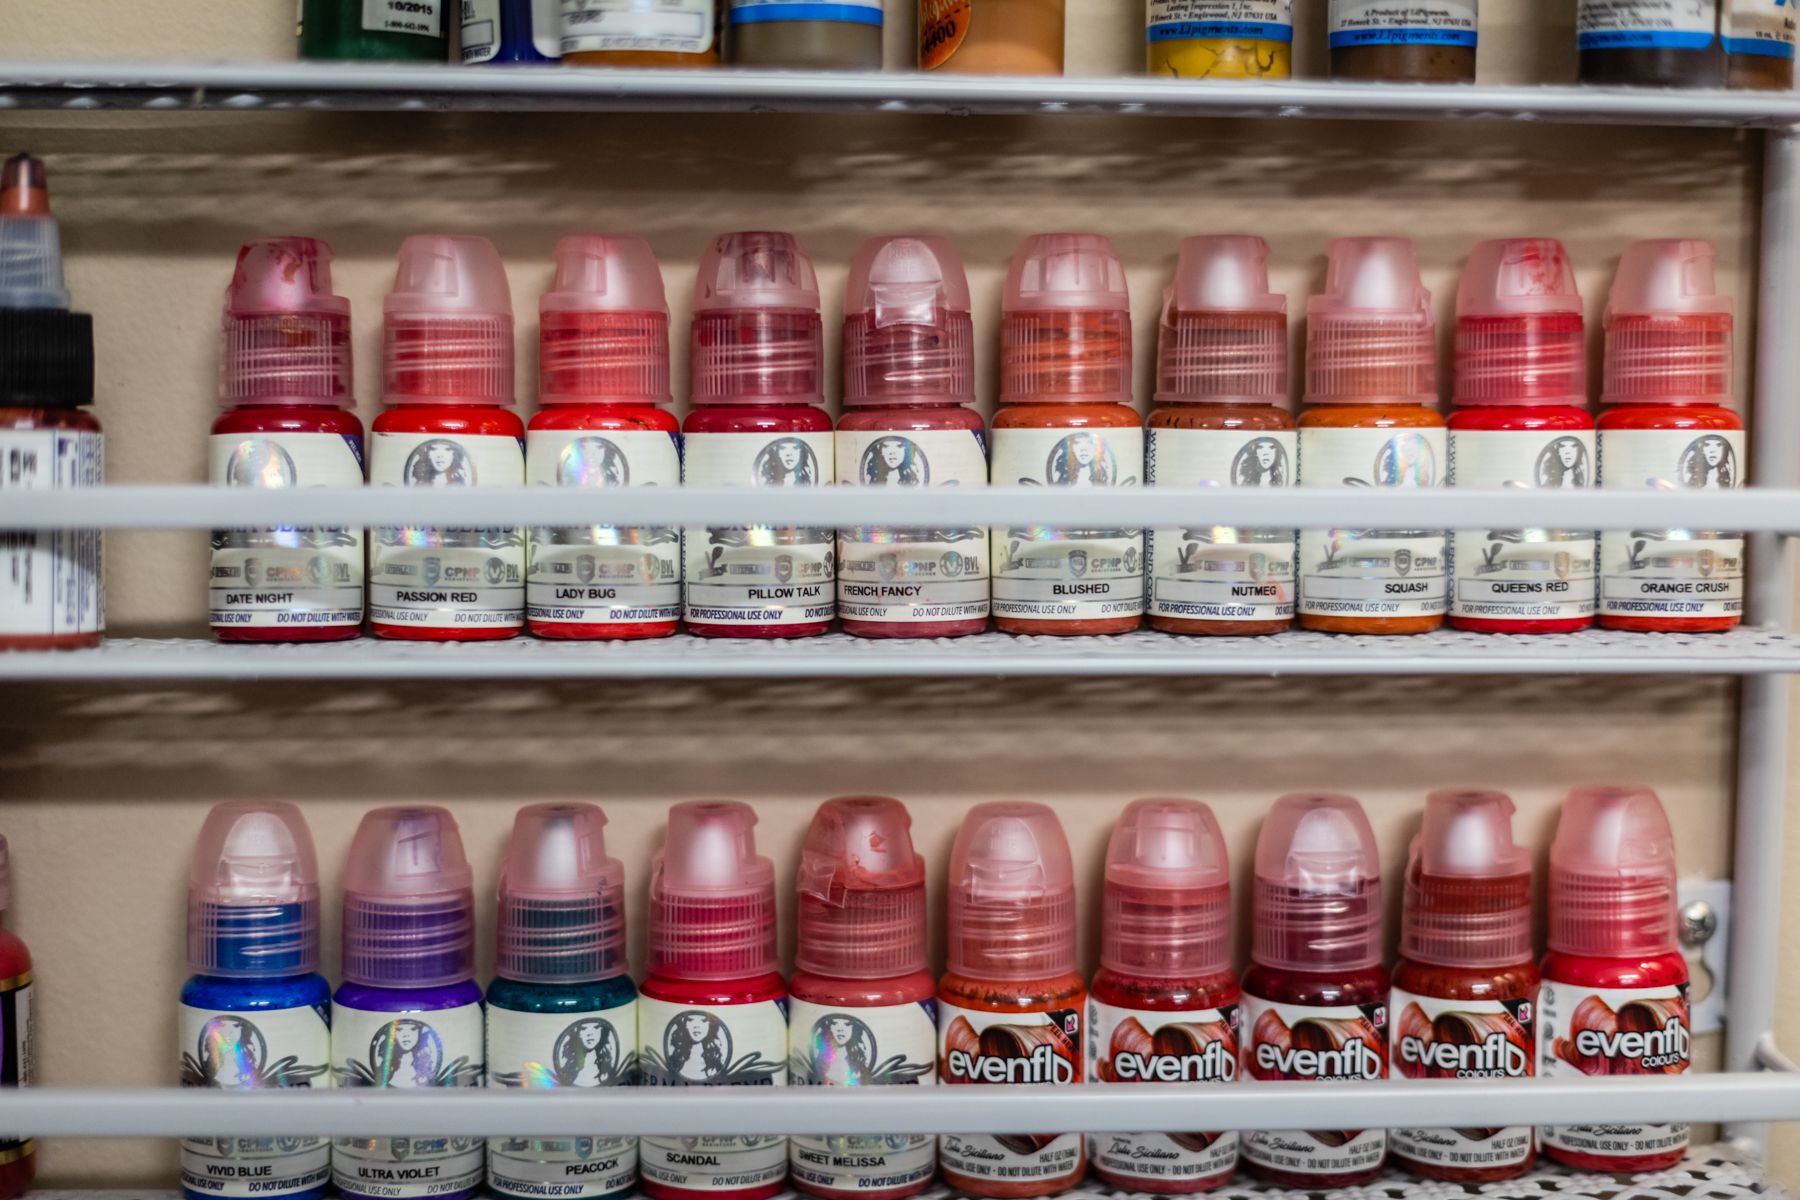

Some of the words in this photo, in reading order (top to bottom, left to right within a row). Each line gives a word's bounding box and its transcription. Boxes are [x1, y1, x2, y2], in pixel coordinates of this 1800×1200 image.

[964, 555, 980, 570] BVL
[555, 588, 586, 599] LADY
[588, 588, 616, 599] BUG
[748, 587, 794, 599] PILLOW
[796, 585, 821, 597] TALK
[844, 585, 878, 597] FRENCH
[881, 586, 922, 597] FANCY
[1053, 583, 1110, 595] BLUSHED
[1231, 585, 1277, 596] NUTMEG
[1384, 582, 1428, 594] SQUASH
[1491, 583, 1543, 594] QUEENS
[1545, 581, 1569, 592] RED
[1640, 583, 1693, 594] ORANGE
[1695, 582, 1729, 593] CRUSH
[226, 593, 253, 605] DATE
[255, 592, 294, 604] NIGHT
[396, 591, 448, 602] PASSION
[451, 591, 478, 603] RED
[859, 606, 869, 616] USE
[869, 607, 888, 617] ONLY
[912, 607, 924, 617] DO
[925, 607, 940, 617] NOT
[941, 606, 962, 616] DILUTE
[963, 605, 977, 615] WITH
[1000, 602, 1041, 614] PROFESSIONAL
[1042, 604, 1056, 614] USE
[1057, 604, 1077, 614] ONLY
[1101, 604, 1112, 613] DO
[1113, 603, 1124, 613] NOT
[1158, 602, 1170, 613] FOR
[1170, 603, 1220, 616] PROFESSIONAL
[1221, 605, 1236, 616] USE
[1237, 605, 1256, 617] ONLY
[1305, 600, 1315, 610] FOR
[1315, 601, 1363, 613] PROFESSIONAL
[1365, 603, 1380, 612] USE
[1380, 603, 1400, 613] ONLY
[1462, 603, 1474, 613] FOR
[1474, 604, 1526, 616] PROFESSIONAL
[1526, 605, 1541, 616] USE
[1542, 605, 1561, 616] ONLY
[1607, 601, 1618, 610] FOR
[1617, 601, 1668, 612] PROFESSIONAL
[1669, 602, 1684, 612] USE
[1685, 602, 1704, 613] ONLY
[236, 613, 253, 623] ONLY
[277, 613, 289, 623] DO
[291, 613, 306, 623] NOT
[396, 611, 409, 621] USE
[409, 611, 429, 622] ONLY
[454, 613, 467, 623] DO
[467, 613, 482, 623] NOT
[552, 609, 565, 619] USE
[565, 609, 585, 620] ONLY
[610, 609, 622, 620] DO
[623, 609, 638, 620] NOT
[691, 608, 700, 619] FOR
[700, 609, 748, 620] PROFESSIONAL
[747, 610, 762, 620] USE
[763, 609, 783, 620] ONLY
[1641, 1053, 1680, 1068] colours
[1456, 1067, 1505, 1080] colours
[1491, 1139, 1506, 1150] HALF
[1600, 1140, 1612, 1150] USE
[1612, 1141, 1628, 1151] ONLY
[1635, 1141, 1644, 1151] DO
[1644, 1139, 1656, 1149] NOT
[666, 1152, 720, 1166] SCANDAL
[798, 1149, 830, 1166] SWEET
[833, 1156, 886, 1167] MELISSA
[1426, 1149, 1443, 1160] ONLY
[1450, 1152, 1459, 1162] DO
[1459, 1152, 1472, 1163] NOT
[1473, 1152, 1493, 1162] DILUTE
[1494, 1150, 1509, 1161] WITH
[565, 1158, 620, 1176] PEACOCK
[1307, 1158, 1317, 1169] DO
[1317, 1158, 1330, 1169] NOT
[1331, 1157, 1351, 1169] DILUTE
[206, 1164, 236, 1177] VIVID
[237, 1165, 272, 1177] BLUE
[358, 1167, 394, 1180] ULTRA
[397, 1166, 441, 1180] VIOLET
[976, 1164, 991, 1175] ONLY
[997, 1166, 1007, 1176] DO
[1007, 1166, 1020, 1177] NOT
[1021, 1165, 1042, 1176] DILUTE
[1043, 1163, 1057, 1174] WITH
[1150, 1164, 1165, 1174] ONLY
[1172, 1165, 1181, 1175] DO
[1183, 1165, 1195, 1175] NOT
[670, 1173, 688, 1184] ONLY
[712, 1176, 724, 1186] DO
[725, 1176, 740, 1185] NOT
[816, 1174, 834, 1185] ONLY
[858, 1178, 870, 1187] DO
[871, 1177, 886, 1187] NOT
[208, 1180, 225, 1190] ONLY
[248, 1182, 261, 1193] DO
[262, 1181, 277, 1192] NOT
[368, 1186, 381, 1194] USE
[382, 1187, 401, 1196] ONLY
[427, 1184, 438, 1193] DO
[439, 1183, 452, 1192] NOT
[501, 1179, 546, 1195] PROFESSIONAL
[548, 1185, 563, 1195] USE
[564, 1184, 584, 1196] ONLY
